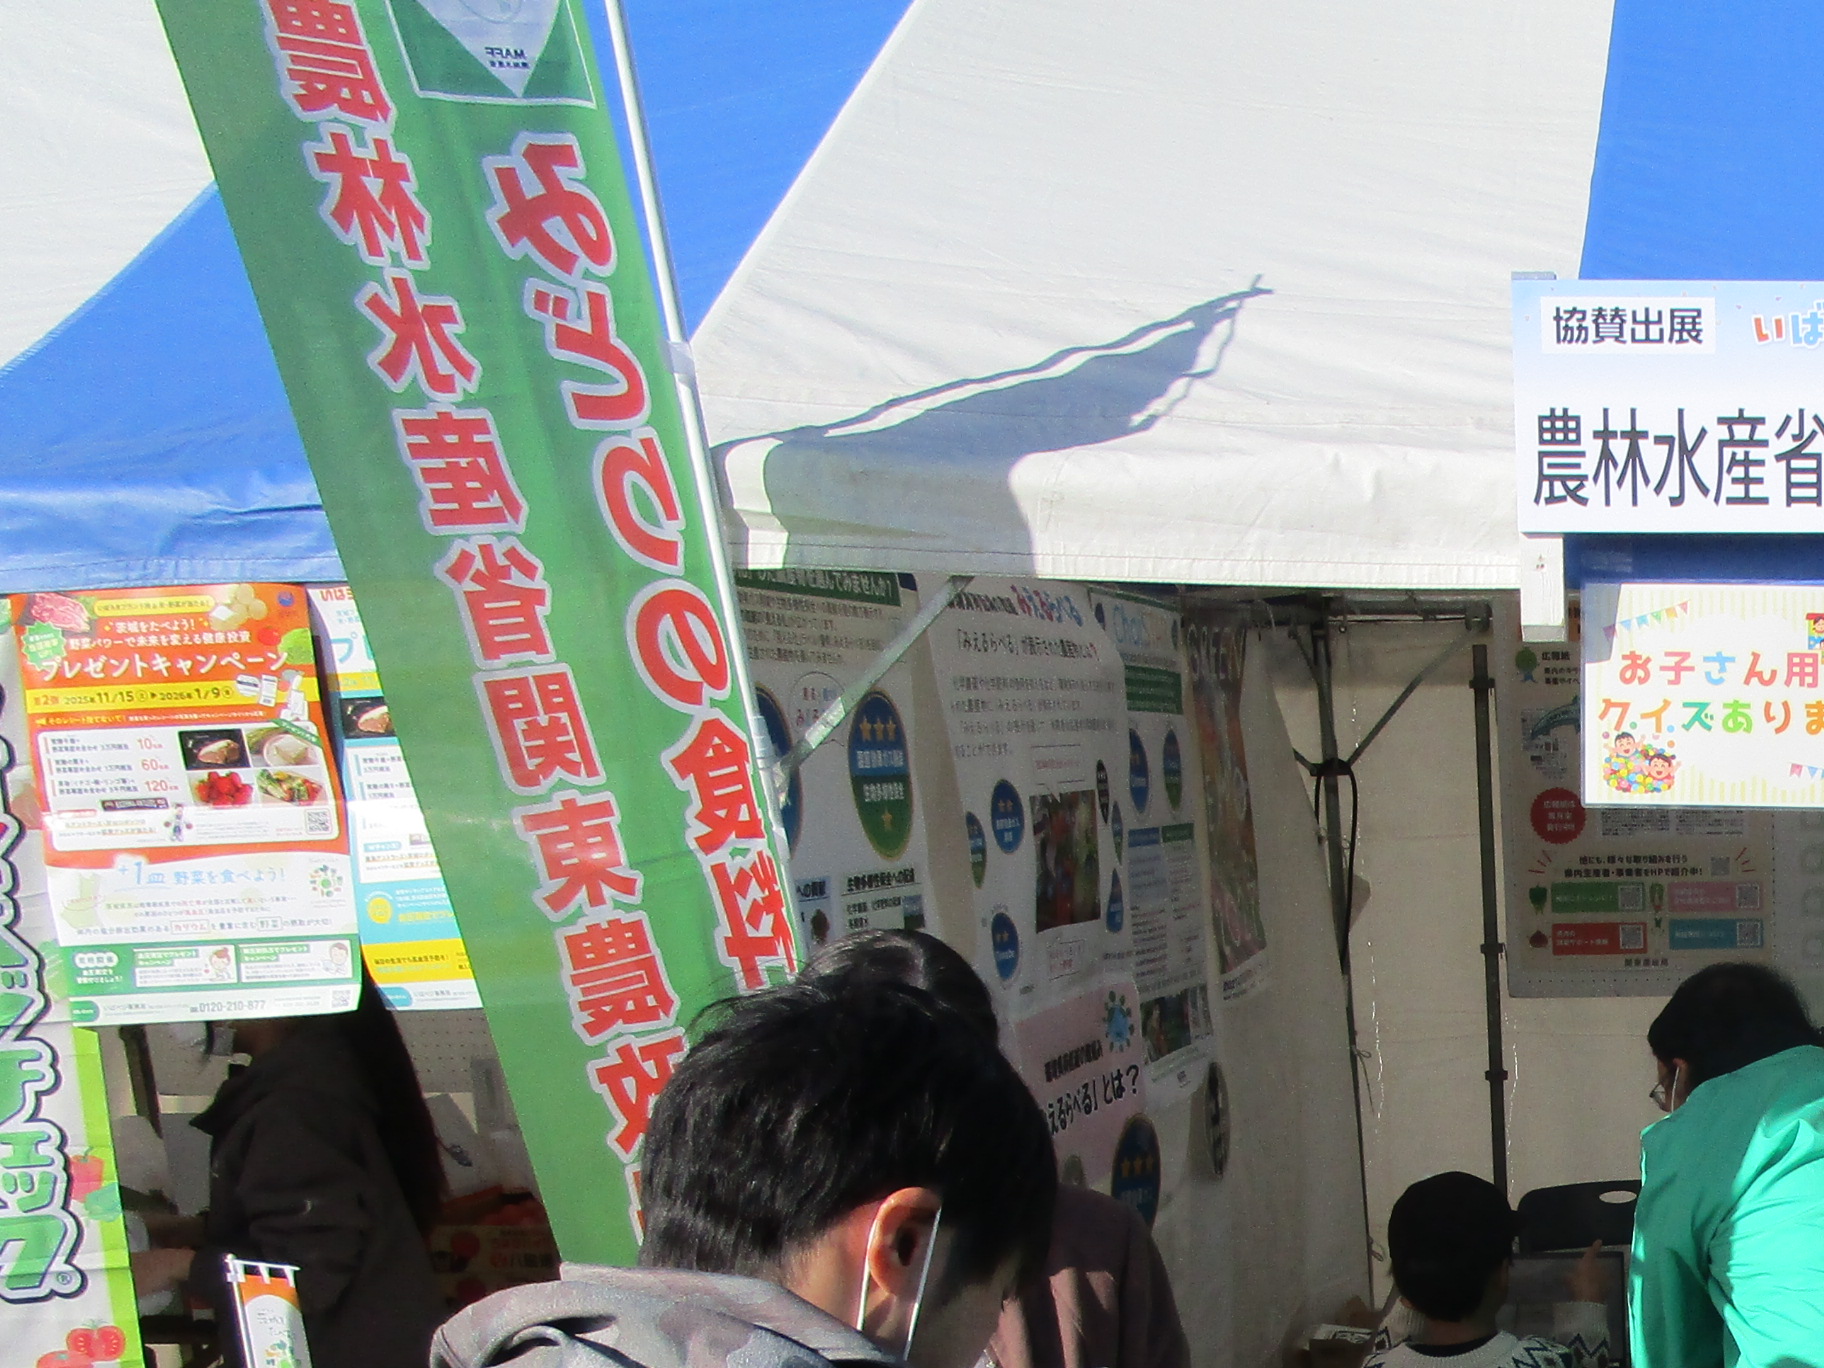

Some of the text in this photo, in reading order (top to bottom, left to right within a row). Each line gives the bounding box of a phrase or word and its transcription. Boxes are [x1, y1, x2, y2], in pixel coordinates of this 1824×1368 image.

[1552, 306, 1704, 345] 協賛出展
[41, 652, 290, 682] プレゼントキャンペーン
[117, 861, 166, 885] +1皿
[200, 999, 267, 1013] 0120-210-877
